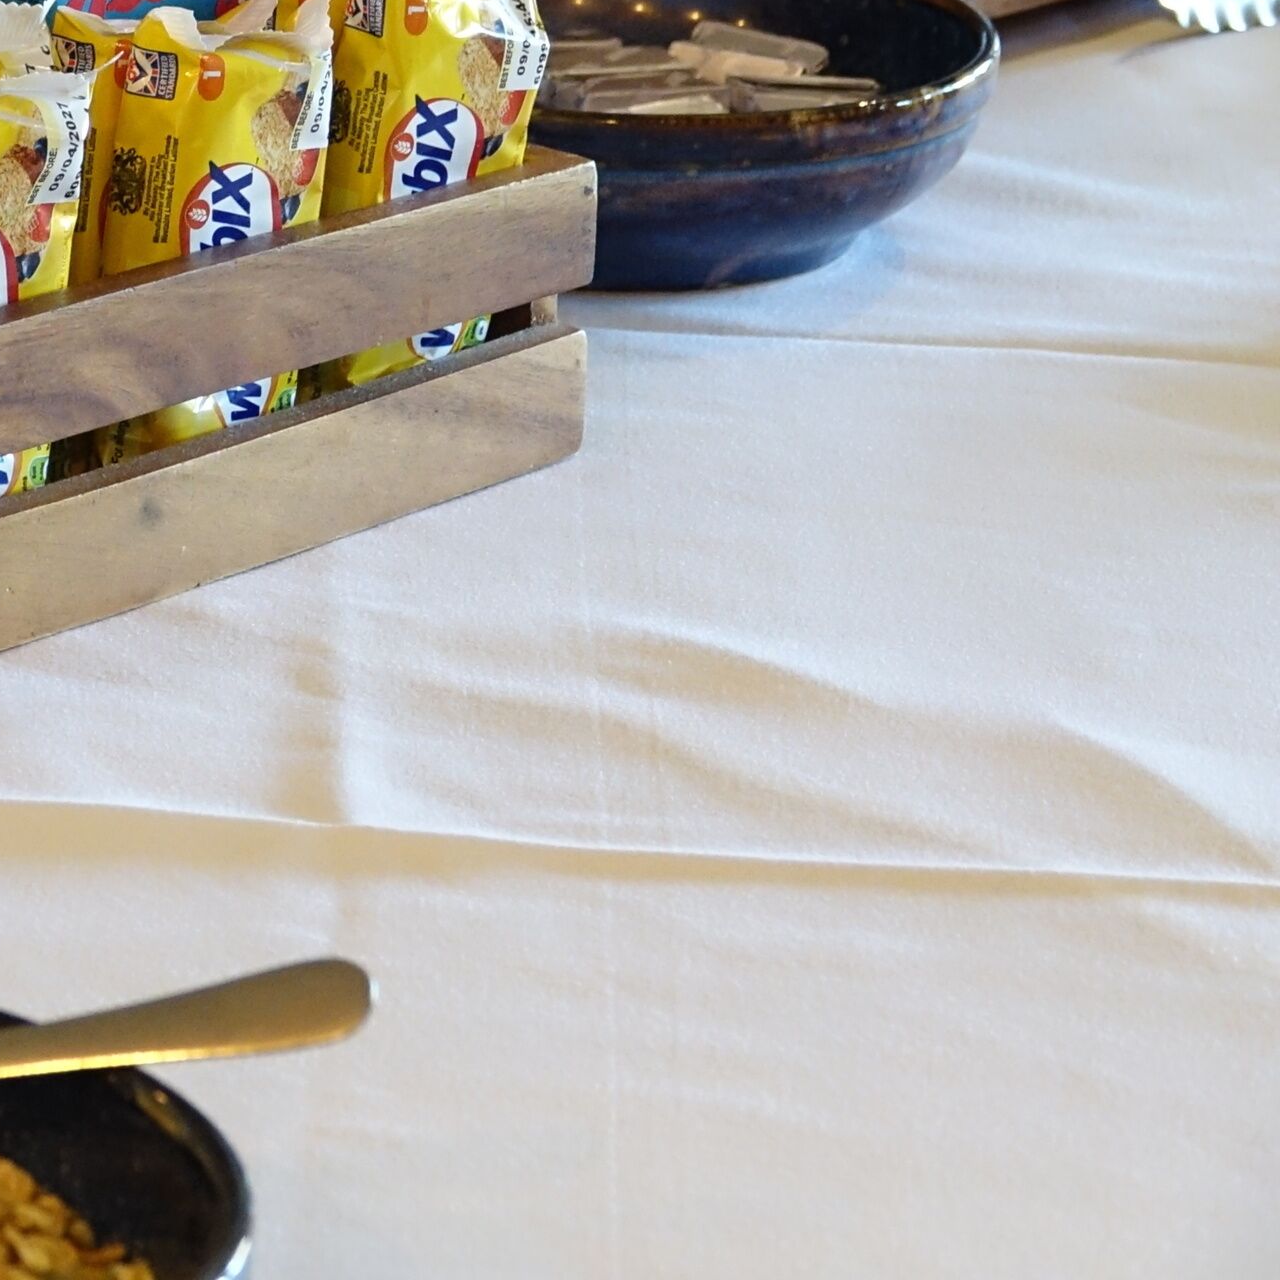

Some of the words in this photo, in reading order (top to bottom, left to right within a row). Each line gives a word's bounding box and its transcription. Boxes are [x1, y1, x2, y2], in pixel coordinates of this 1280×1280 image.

[407, 5, 426, 15] 1
[158, 55, 168, 96] CERTIFIED
[166, 54, 177, 99] STANDARDS
[203, 70, 221, 80] 1
[499, 67, 510, 89] BEST
[48, 101, 80, 192] 09/04/2027
[291, 128, 301, 149] BEST
[26, 184, 42, 205] BEST
[39, 148, 58, 182] BEFORE:
